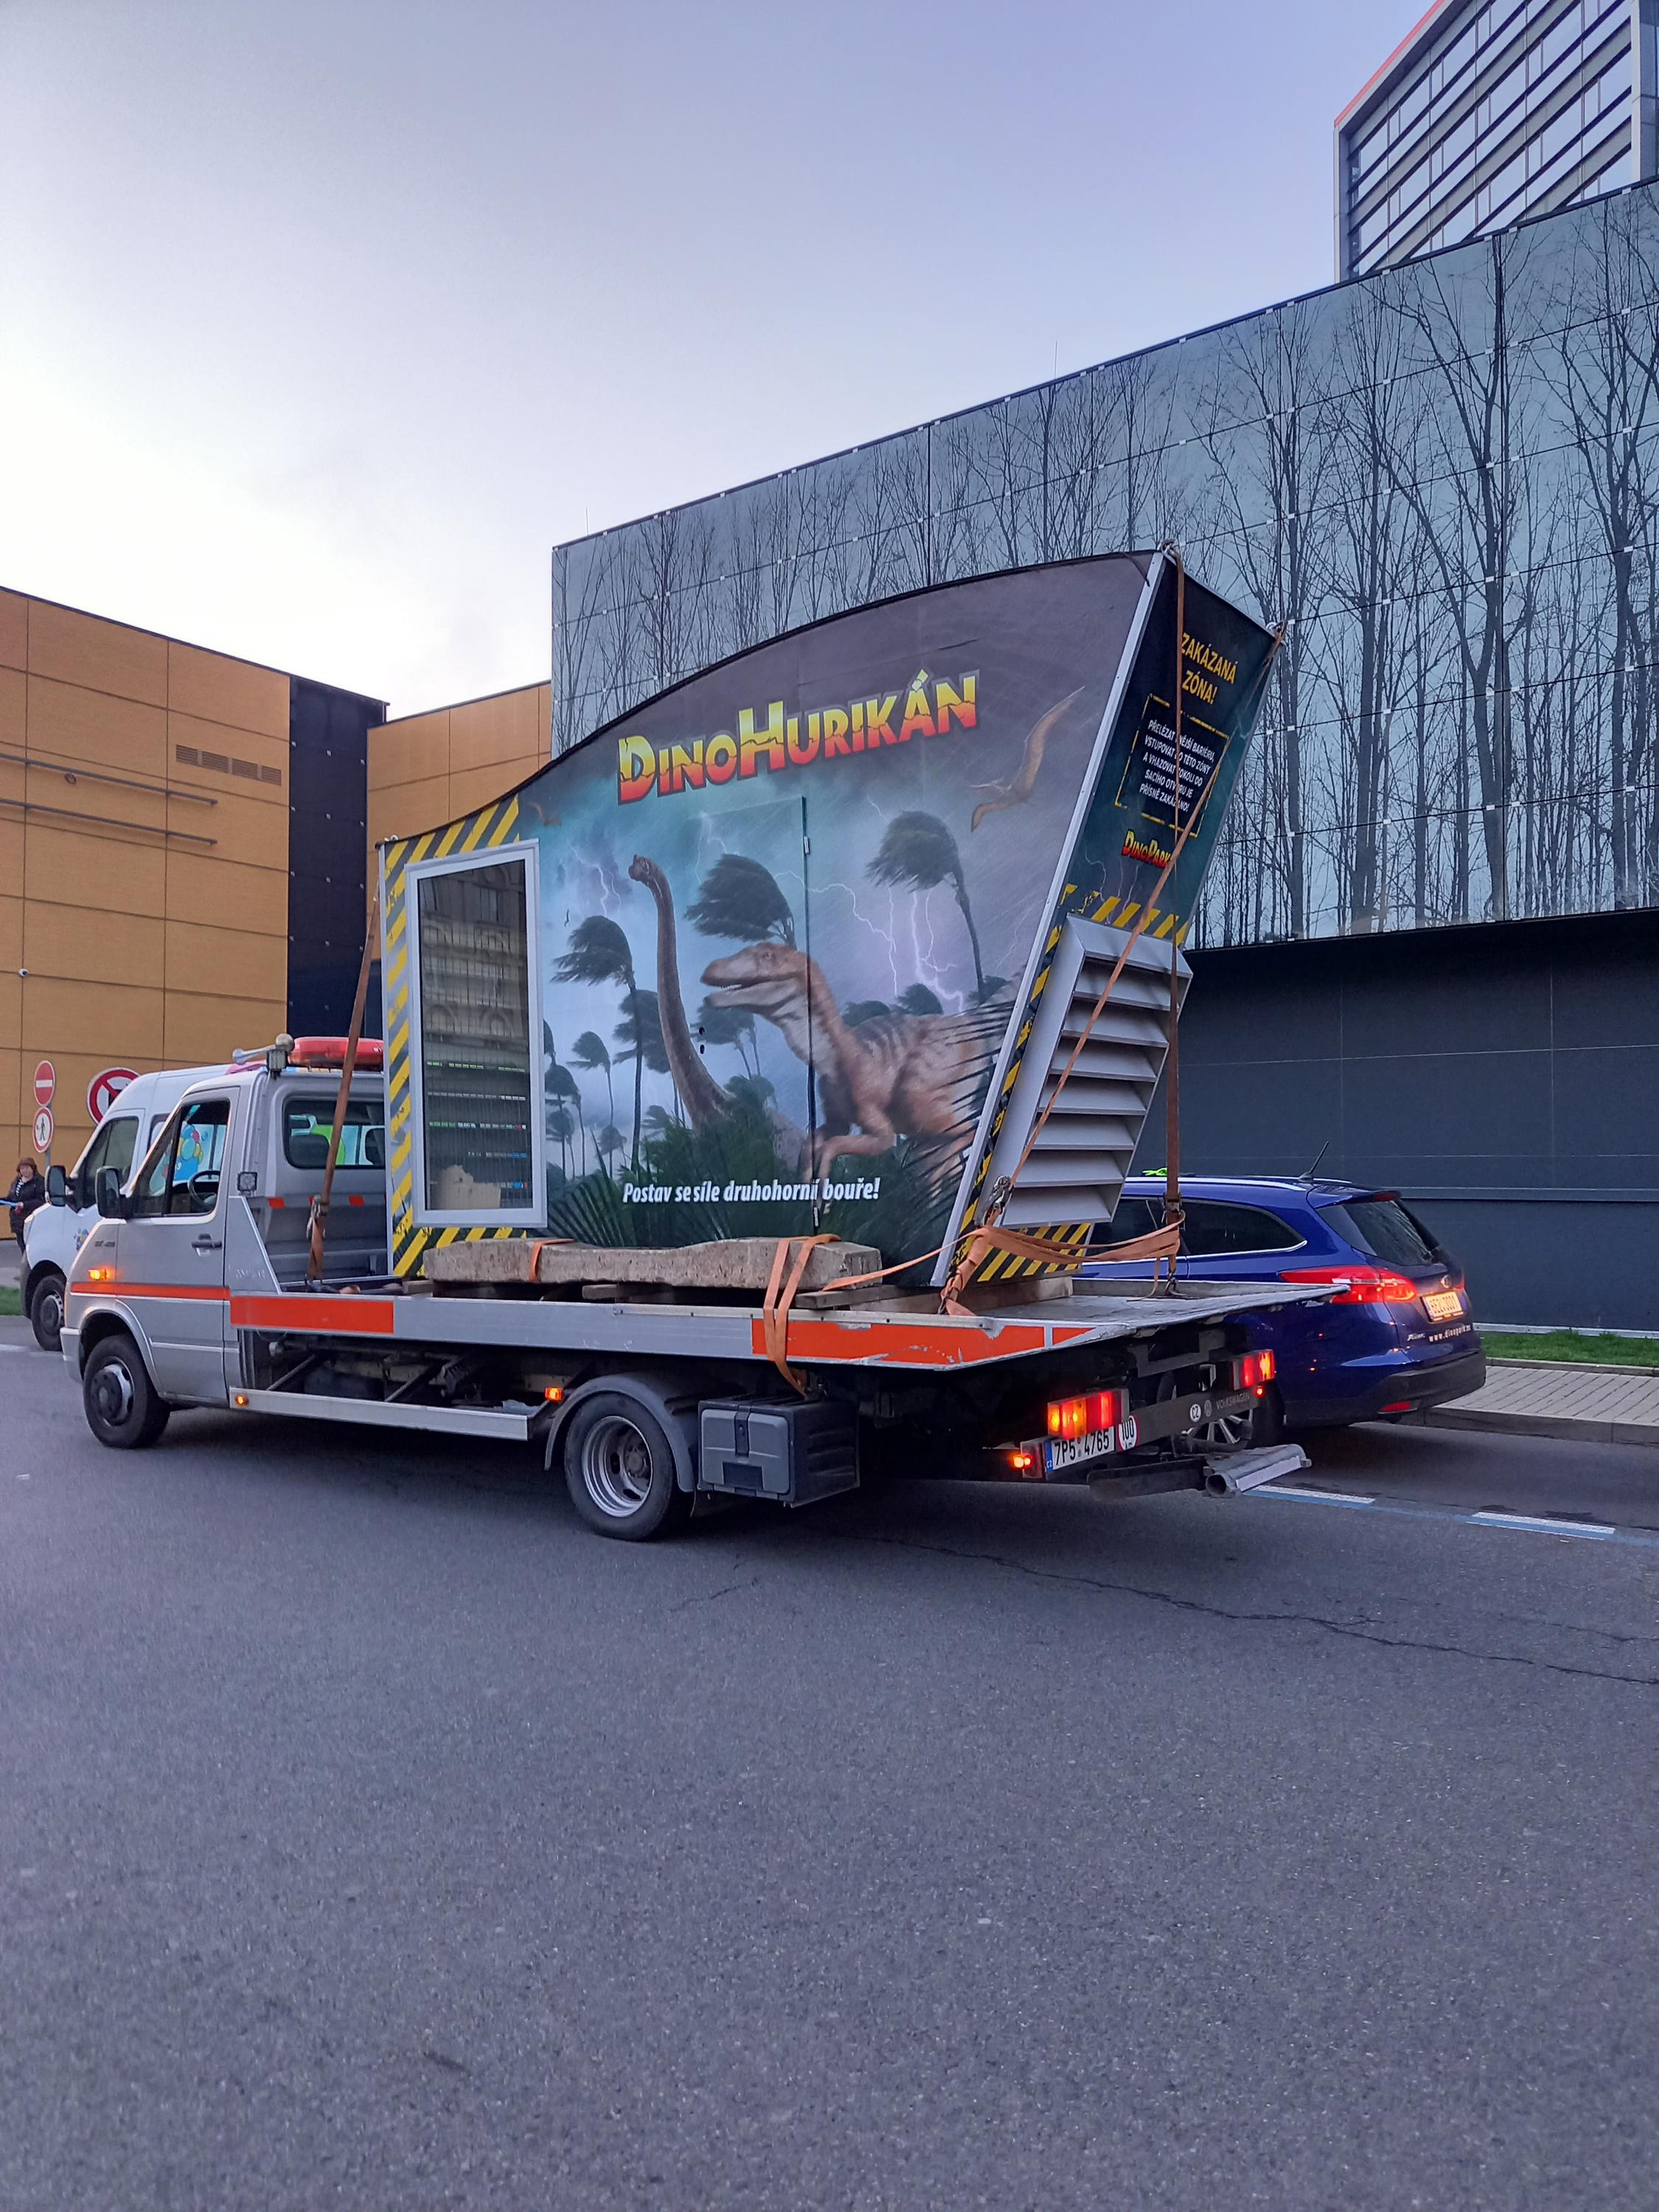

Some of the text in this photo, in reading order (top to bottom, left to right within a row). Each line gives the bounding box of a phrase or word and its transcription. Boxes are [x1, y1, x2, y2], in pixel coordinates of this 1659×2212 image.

[1181, 632, 1238, 684] ZAKÁZANÁ
[1182, 669, 1217, 704] ZÓNA!
[1144, 734, 1176, 758] VSTUPOVAT
[1175, 734, 1194, 751] NĚJŠÍ
[1142, 752, 1203, 787] A VHAZOVAT OKOLI DO
[1165, 778, 1187, 796] OTVRU
[1186, 787, 1194, 799] JE
[622, 1177, 881, 1203] Postav se síle druhohorní bouře!
[1054, 1429, 1110, 1466] 7P5 4765
